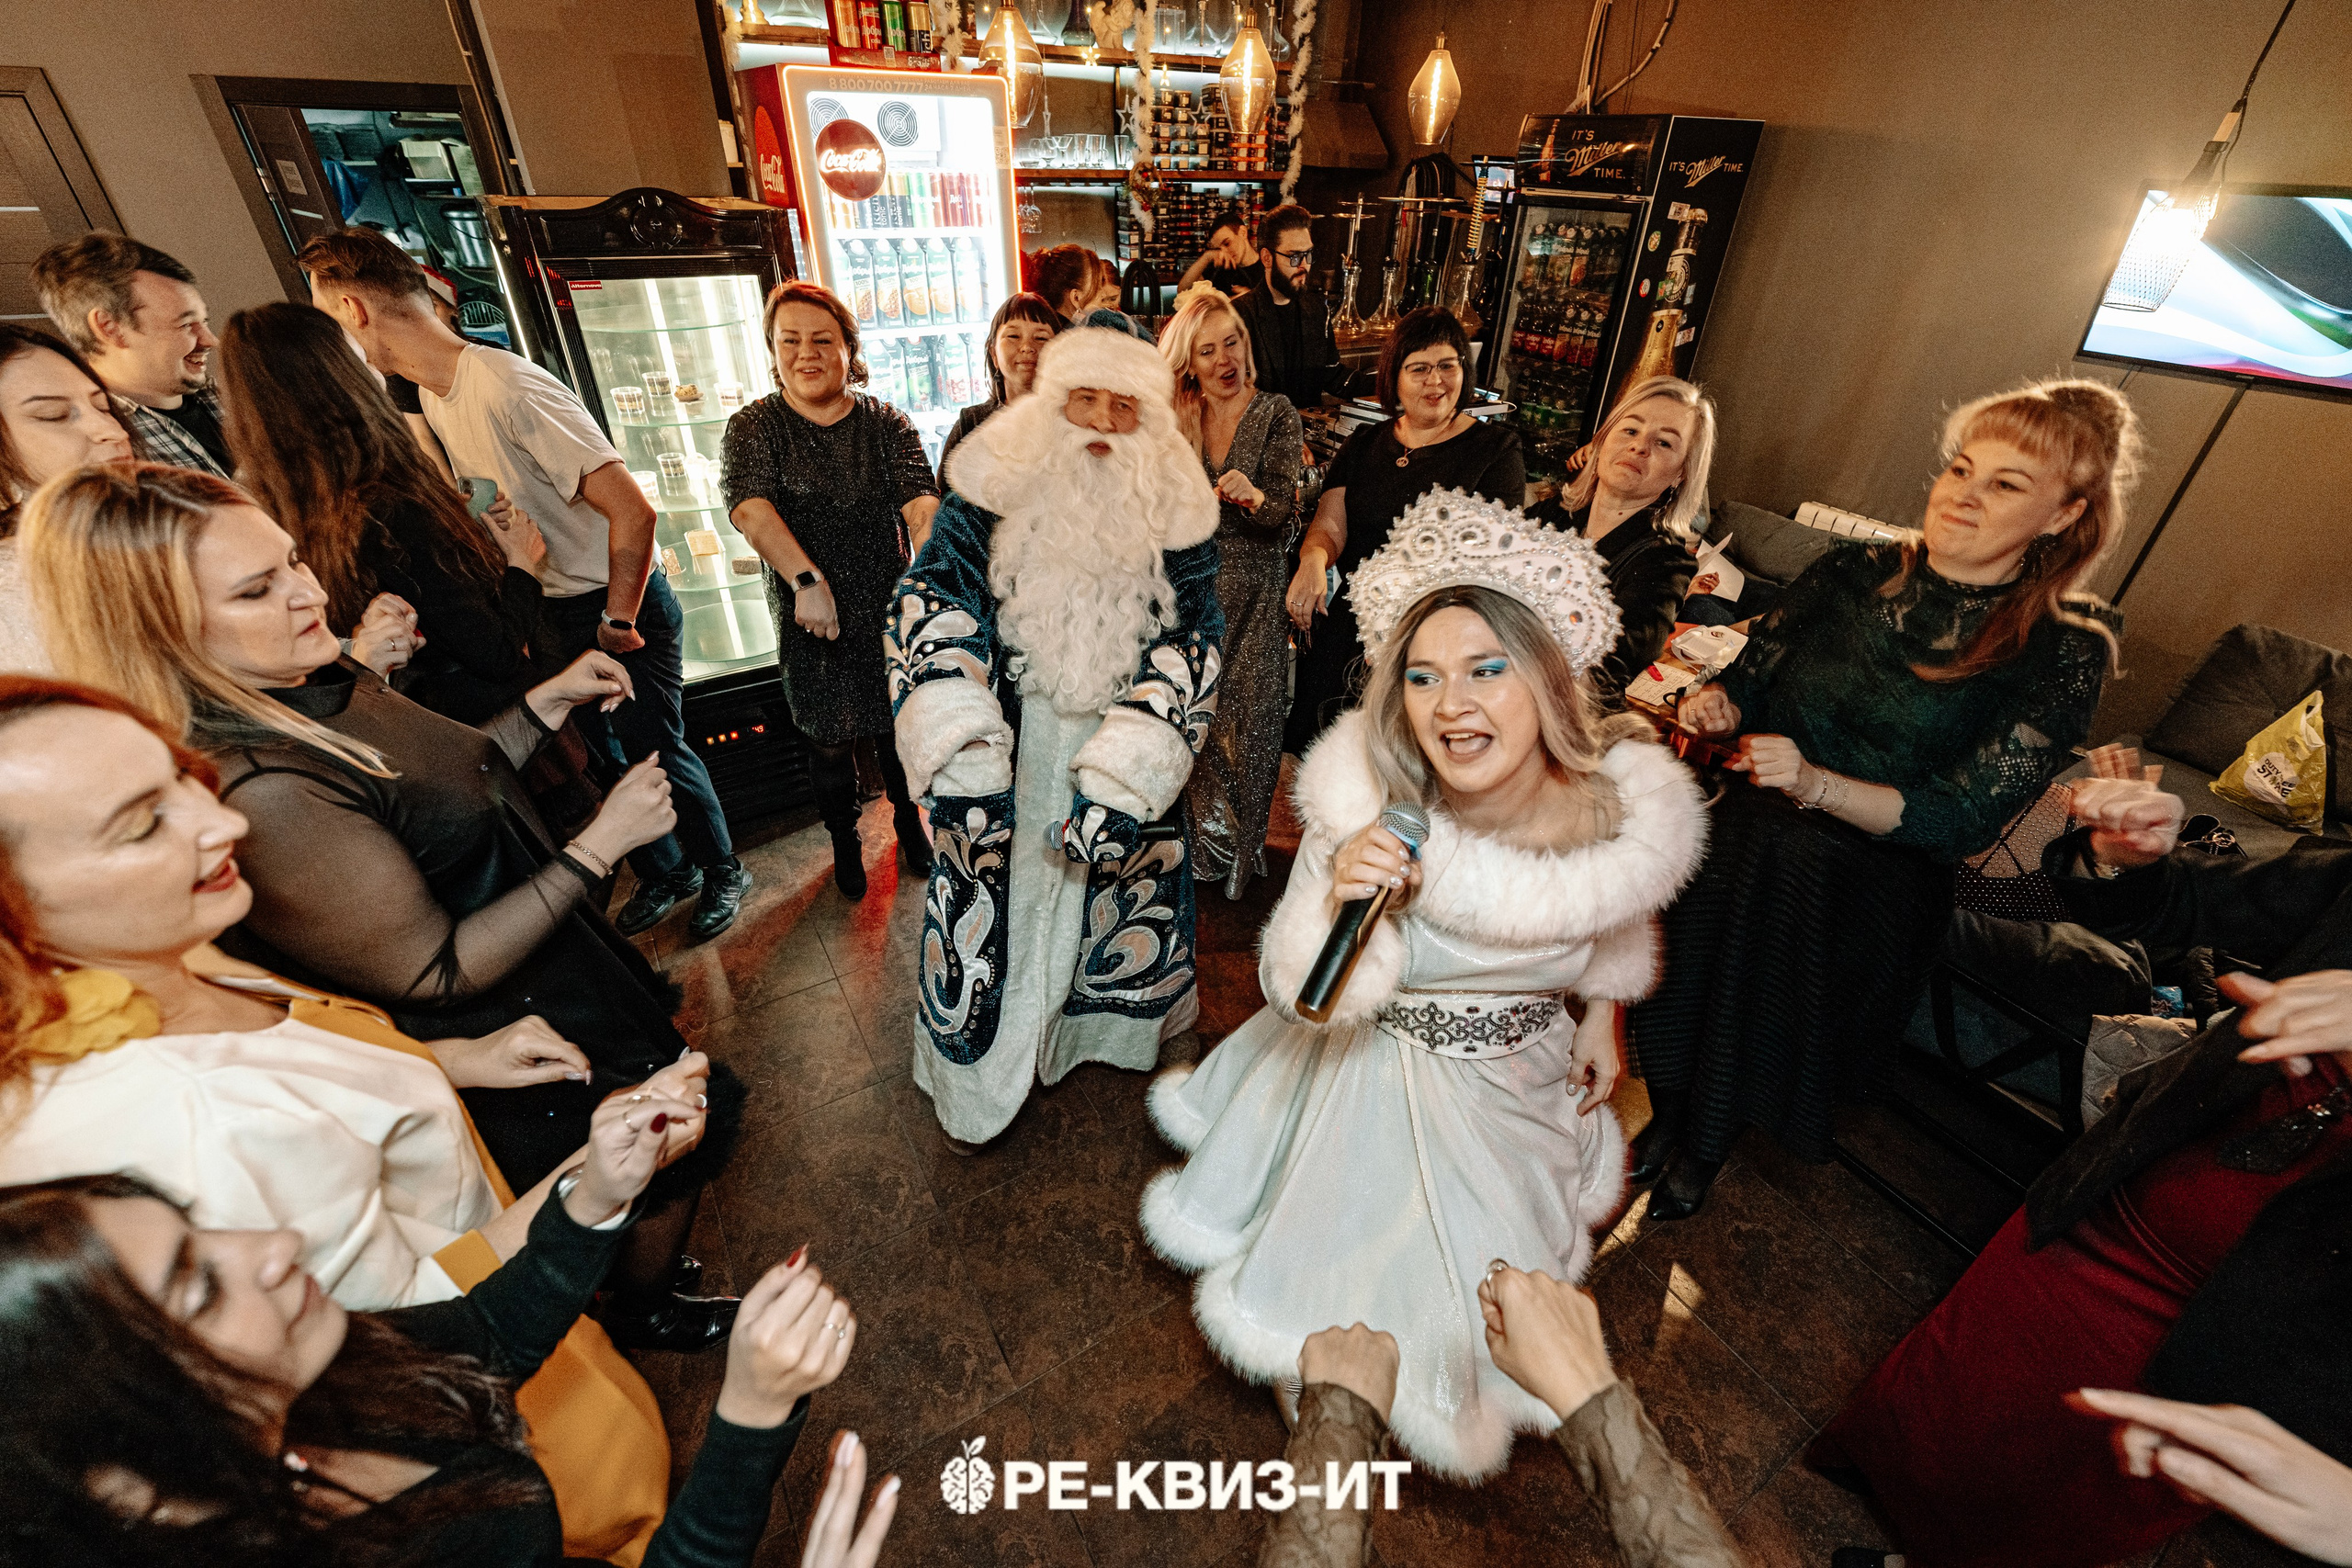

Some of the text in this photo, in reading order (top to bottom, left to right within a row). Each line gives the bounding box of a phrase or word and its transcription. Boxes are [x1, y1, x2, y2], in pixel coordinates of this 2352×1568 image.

[829, 77, 837, 90] 8
[839, 77, 865, 91] 800
[866, 79, 893, 92] 700
[893, 81, 924, 93] 7777
[1571, 130, 1595, 141] IT'S
[1565, 141, 1623, 177] Miller
[1594, 167, 1626, 179] TIME.
[1668, 155, 1745, 188] IT'S Miller TIME.
[854, 278, 870, 287] 100%
[2265, 758, 2282, 775] DUTY
